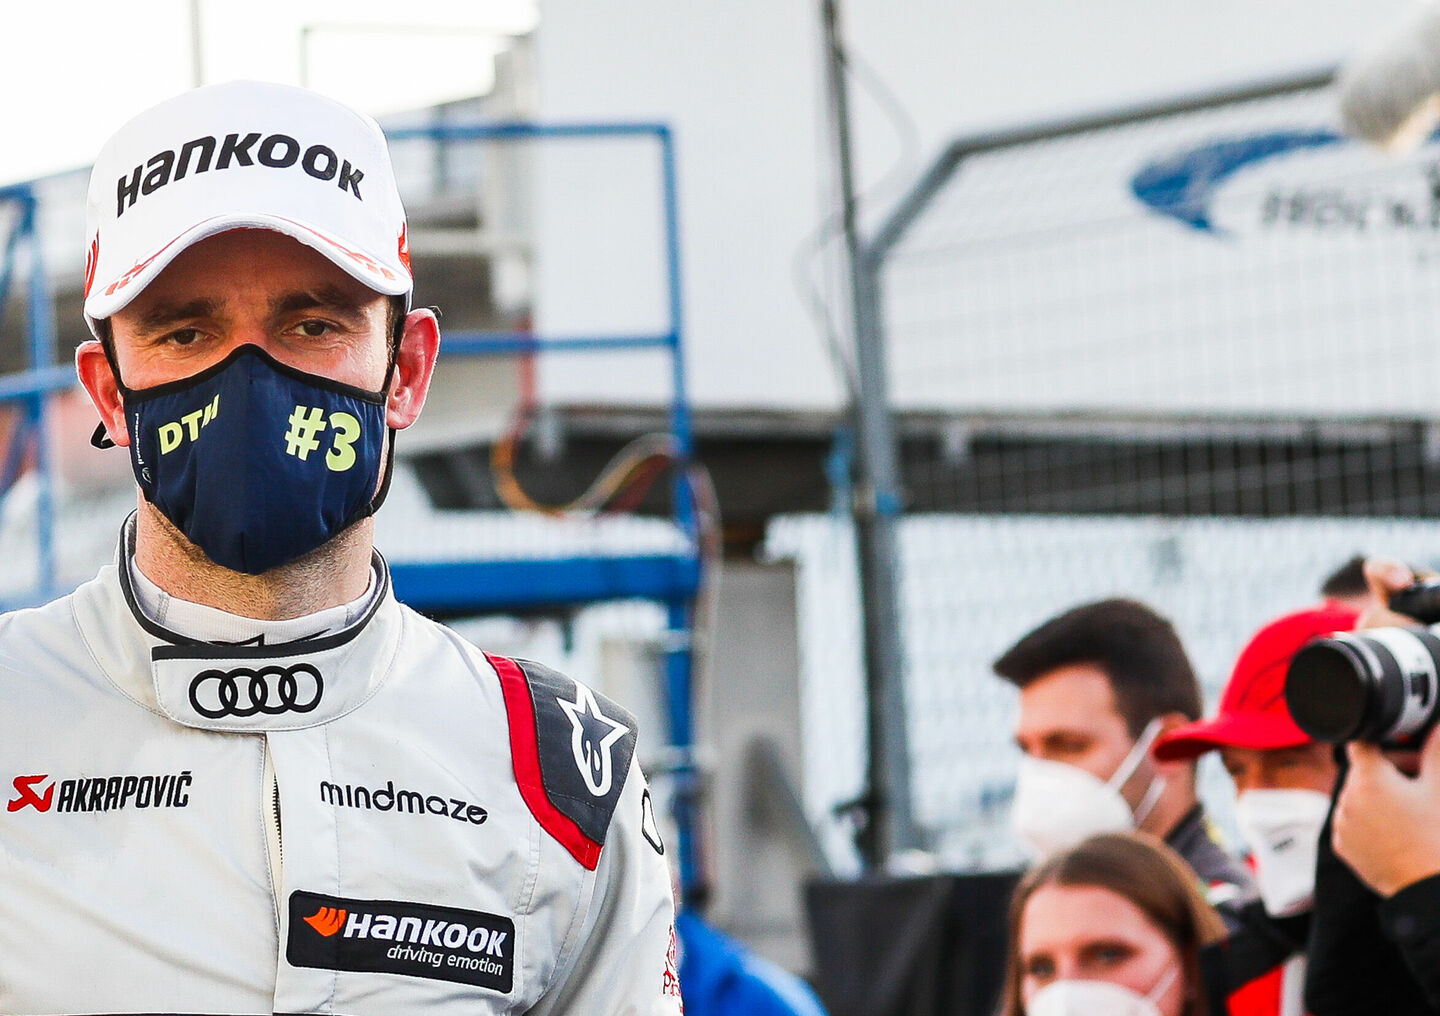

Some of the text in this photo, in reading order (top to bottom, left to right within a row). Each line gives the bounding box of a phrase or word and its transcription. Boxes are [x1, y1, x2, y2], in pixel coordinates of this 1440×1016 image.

[284, 405, 361, 472] #3
[320, 779, 488, 826] mindmaze
[386, 944, 503, 976] driving emotion
